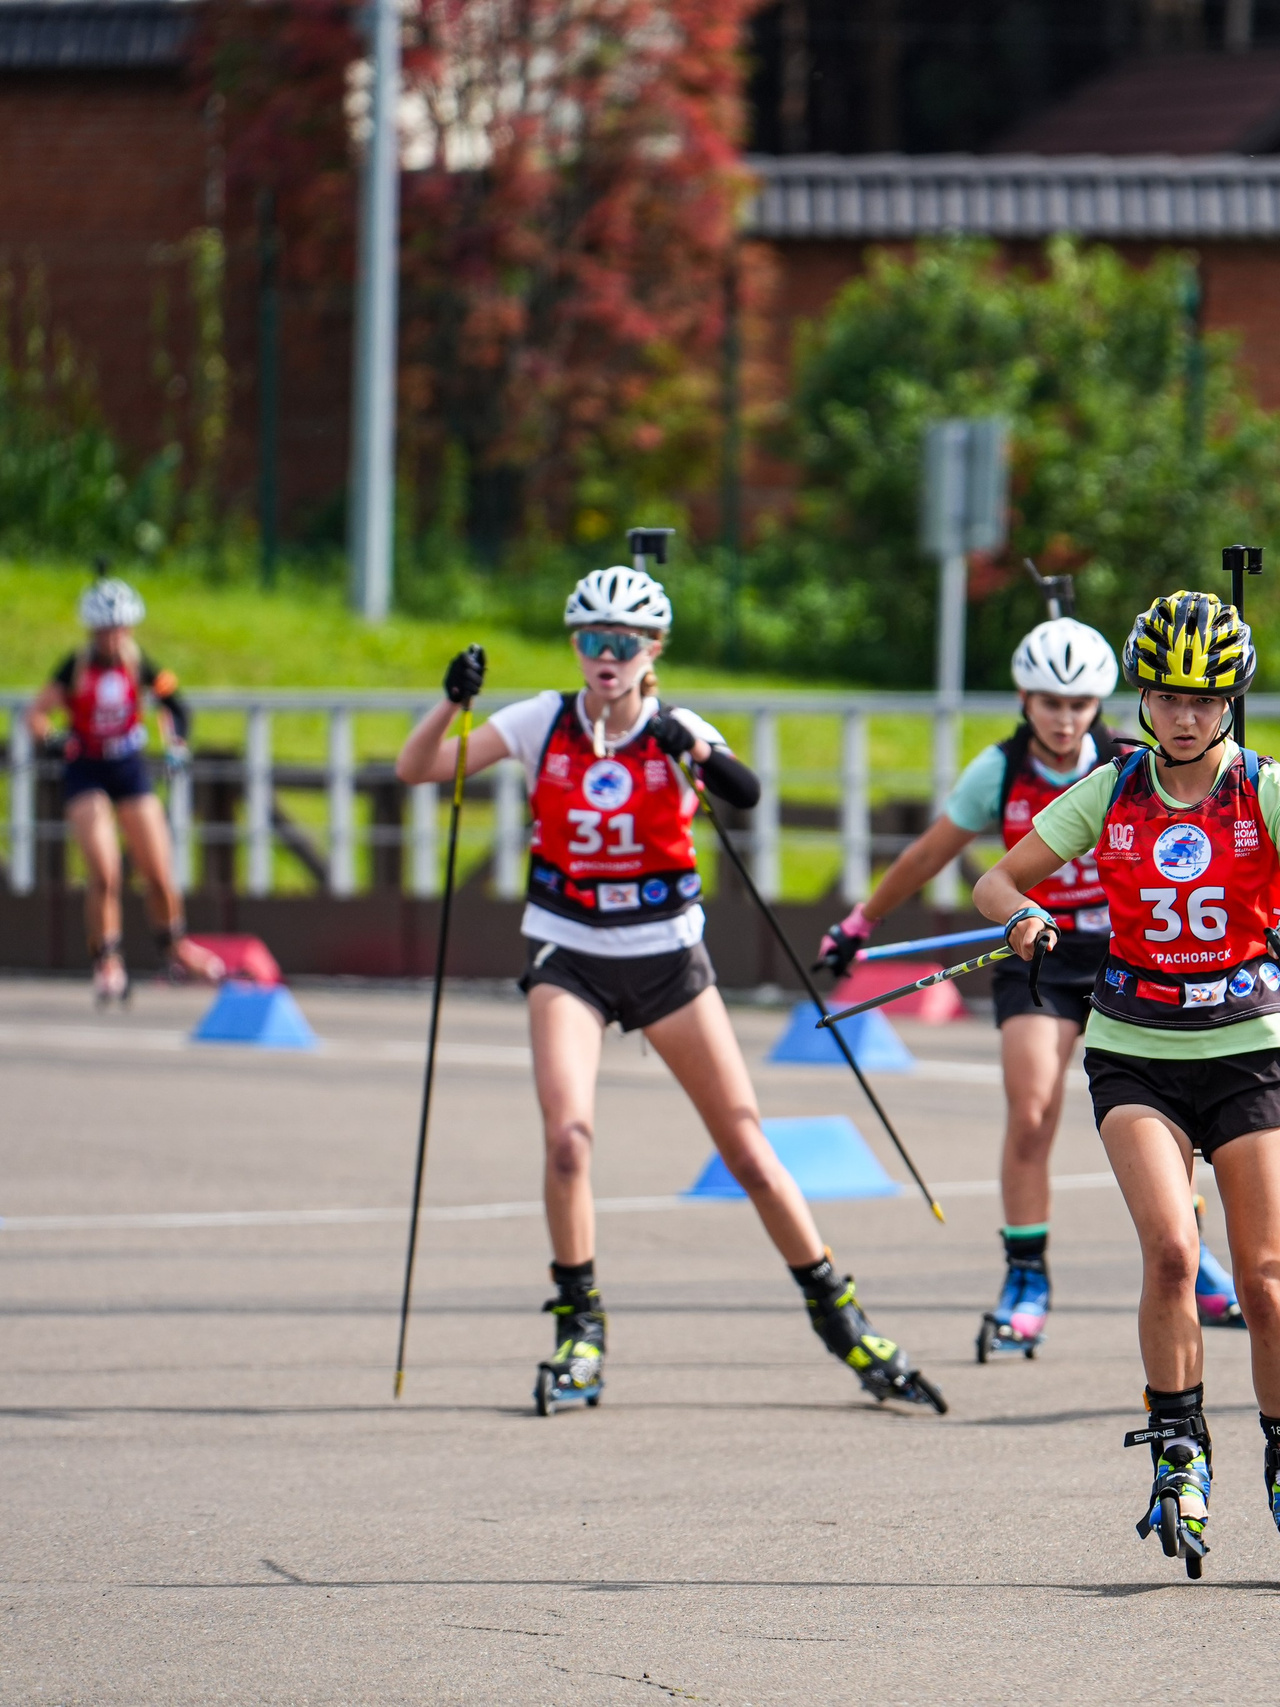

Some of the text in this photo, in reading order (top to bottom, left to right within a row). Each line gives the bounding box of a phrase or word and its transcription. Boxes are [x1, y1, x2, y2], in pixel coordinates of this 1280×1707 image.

[567, 808, 644, 856] 31
[1140, 886, 1229, 942] 36
[1133, 1428, 1176, 1442] SPINE
